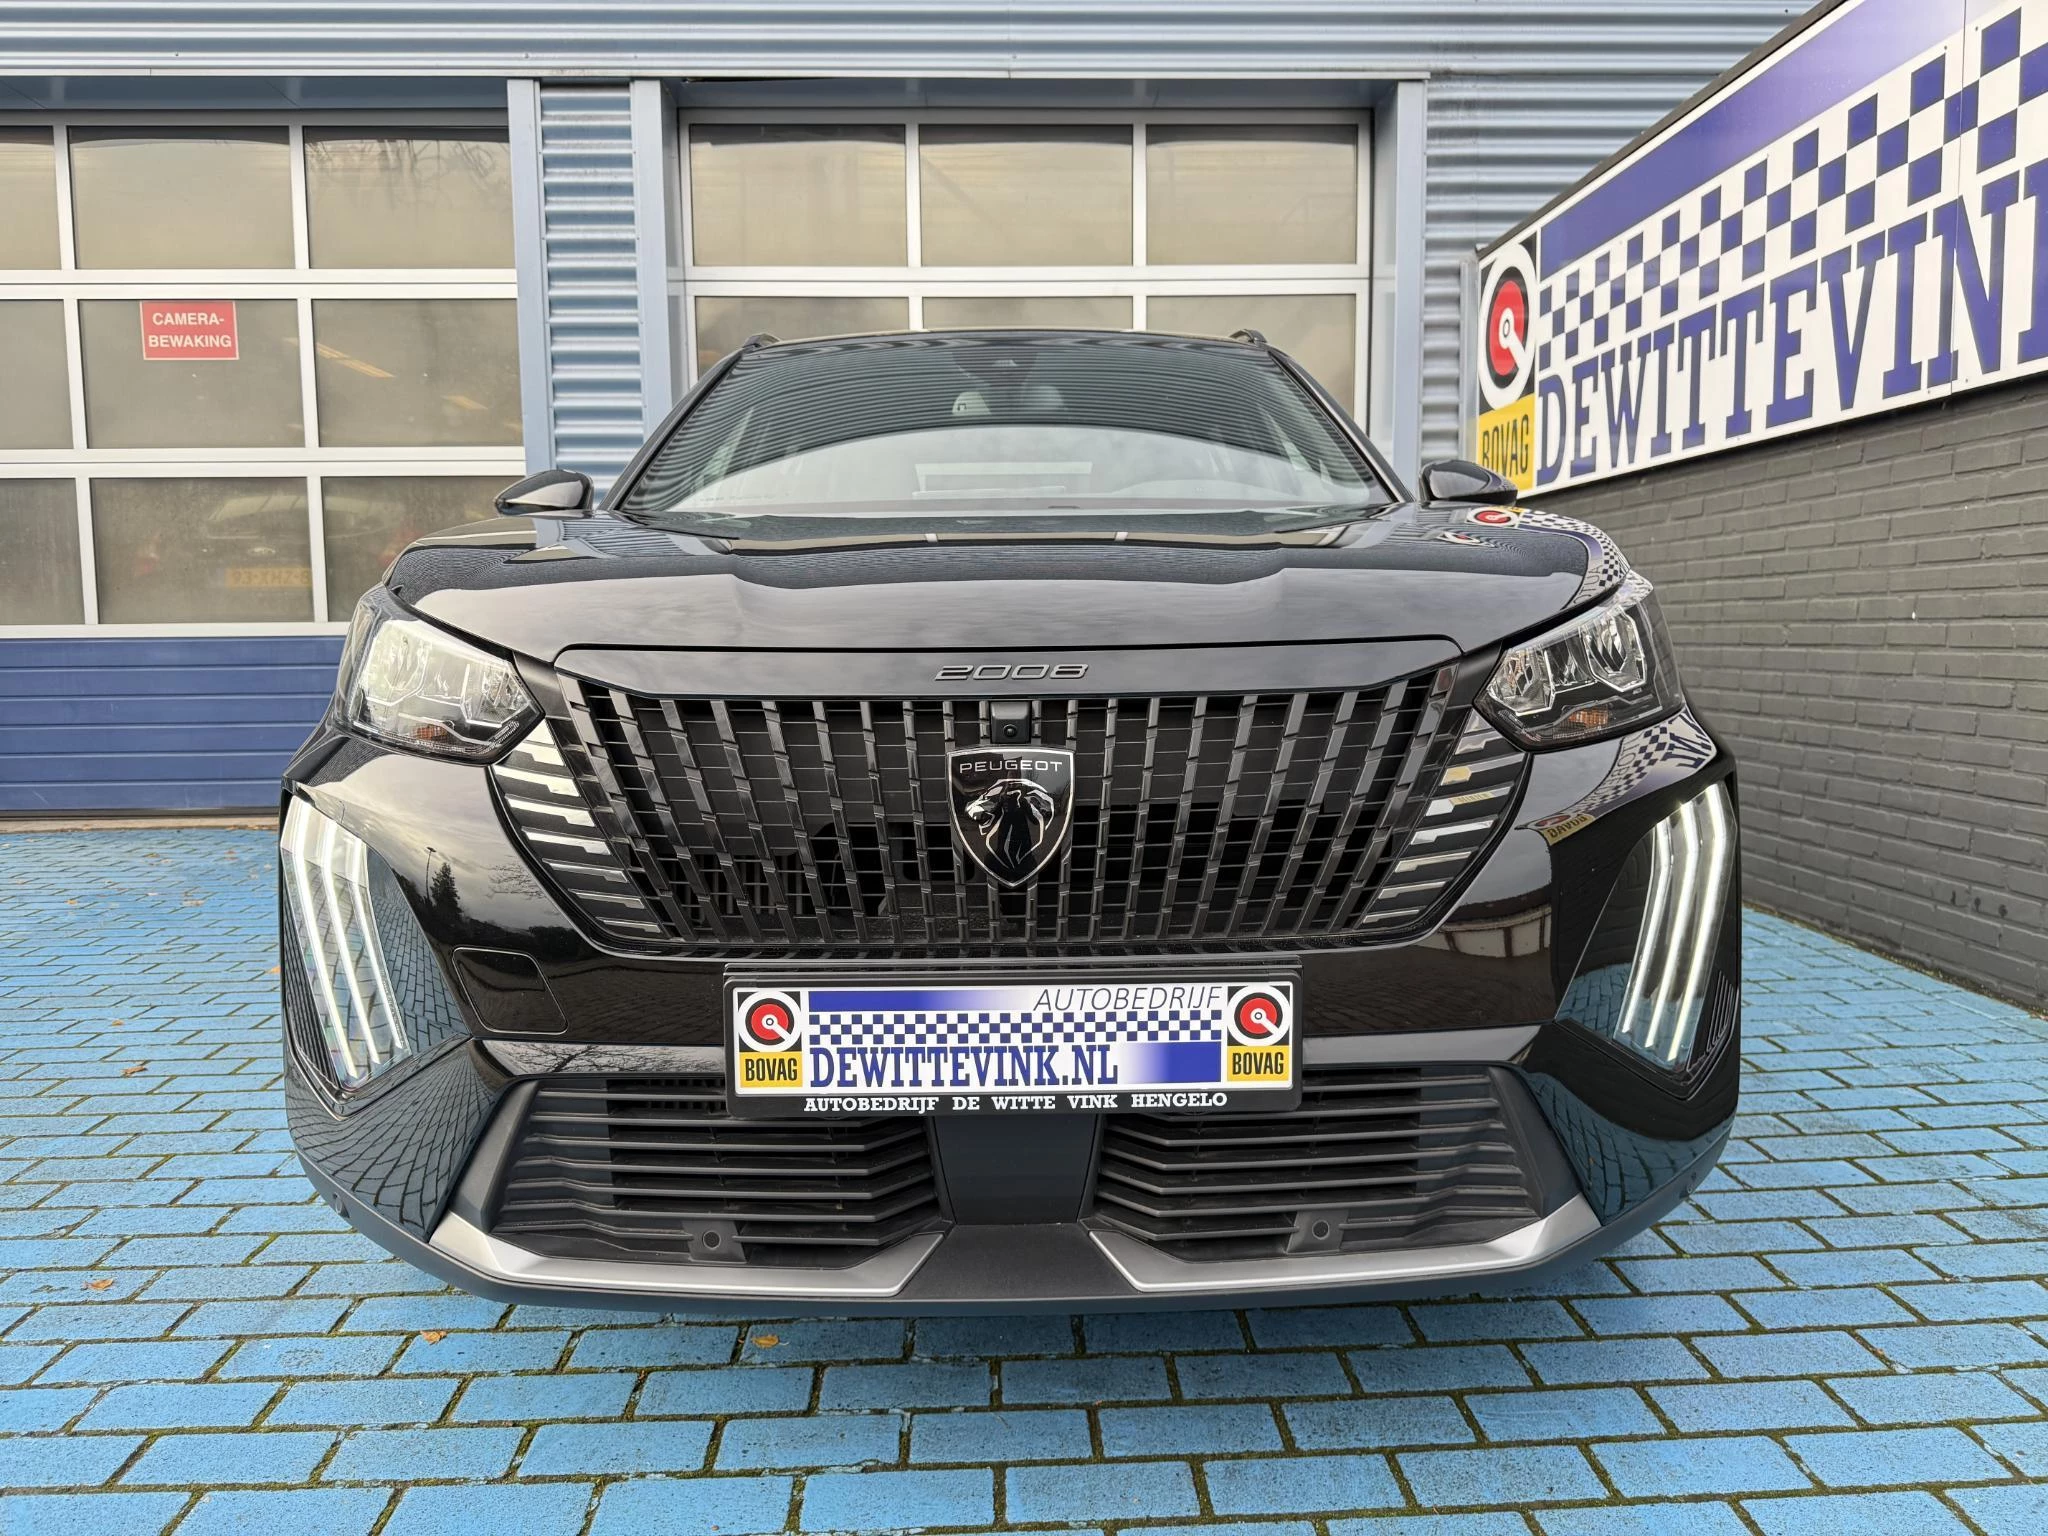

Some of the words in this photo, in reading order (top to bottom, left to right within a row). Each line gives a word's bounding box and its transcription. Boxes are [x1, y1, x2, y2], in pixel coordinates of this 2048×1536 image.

[152, 312, 225, 326] CAMERA-
[148, 334, 232, 348] BEWAKING
[1482, 413, 1529, 477] BOVAG
[934, 663, 1089, 682] 2008
[959, 759, 1063, 774] PEUGEOT
[1033, 986, 1222, 1011] AUTOBEDRIJF
[744, 1057, 798, 1082] BOVAG
[810, 1044, 1119, 1088] DEWITTEVINK.NL
[1231, 1051, 1285, 1076] BOVAG
[803, 1096, 940, 1114] AUTOBEDRIJF
[952, 1096, 981, 1111] DE
[991, 1095, 1056, 1110] WITTE
[1066, 1094, 1119, 1109] VINK
[1130, 1092, 1228, 1108] HENGELO
